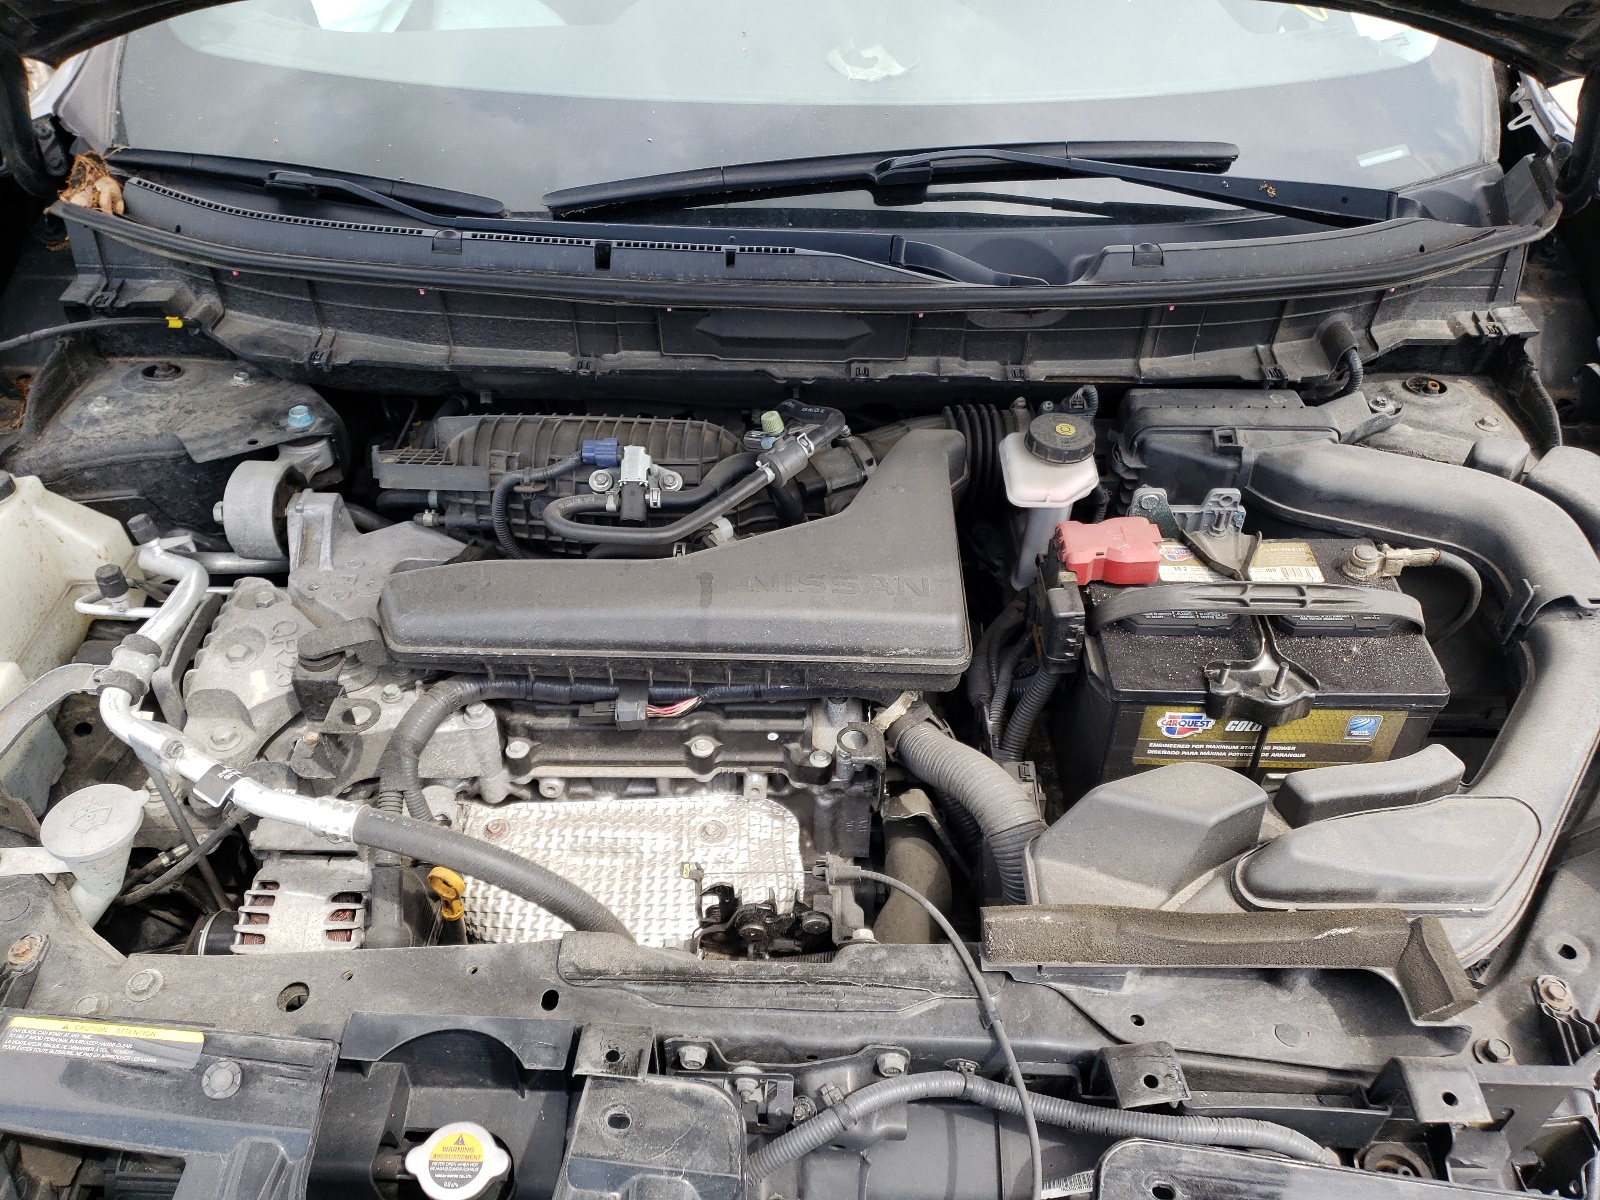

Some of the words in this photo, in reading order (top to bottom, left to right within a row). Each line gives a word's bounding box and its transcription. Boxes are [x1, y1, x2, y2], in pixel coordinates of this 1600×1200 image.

[749, 573, 930, 597] NISSAN
[1161, 719, 1212, 728] CARQUEST
[74, 1024, 108, 1033] CAUTION
[116, 1028, 157, 1037] ATTENTION
